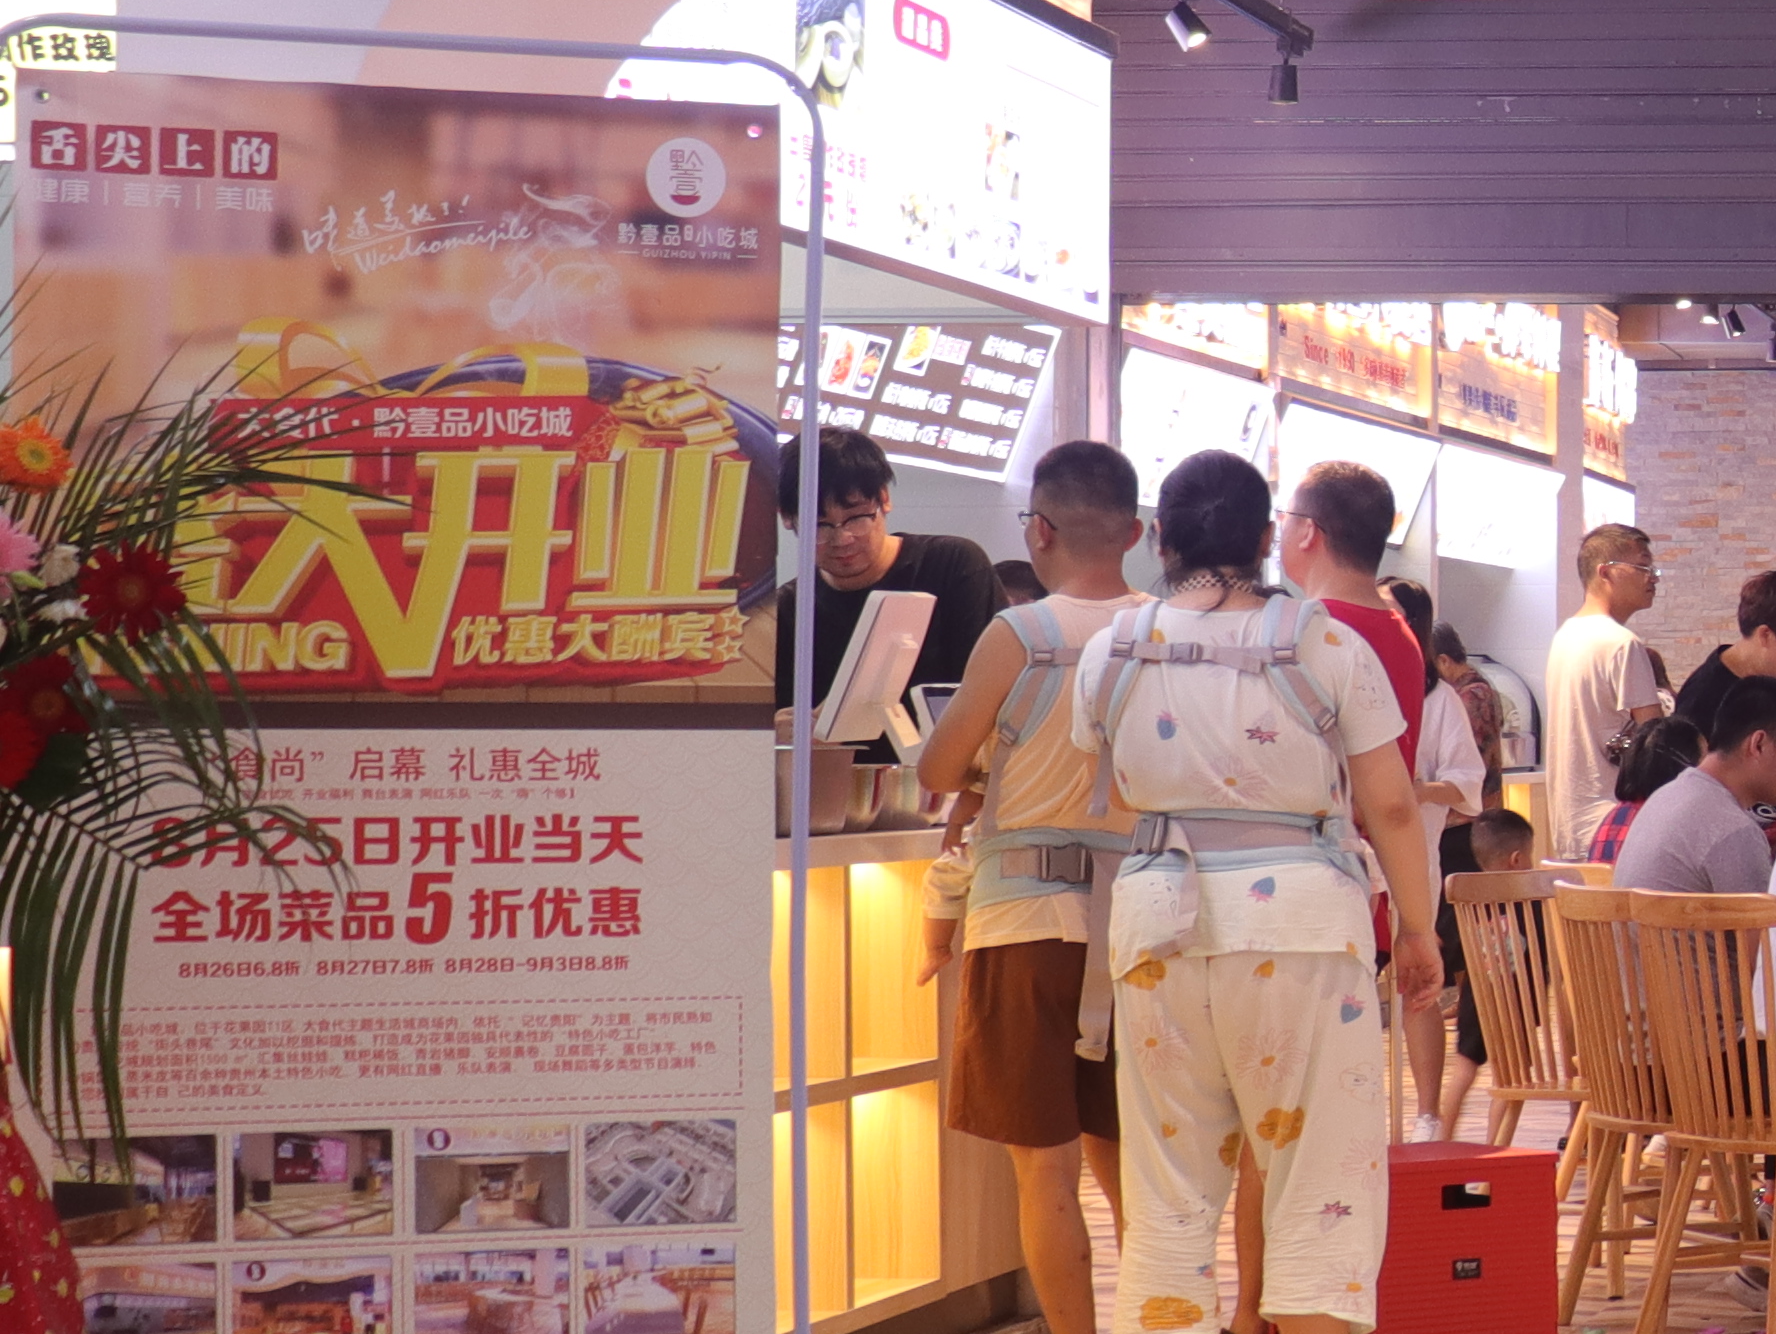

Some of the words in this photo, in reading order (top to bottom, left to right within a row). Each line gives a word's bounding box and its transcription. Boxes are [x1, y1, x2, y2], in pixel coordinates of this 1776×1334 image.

[37, 125, 273, 176] 舌尖上的
[450, 608, 722, 667] 优惠大酬宾
[348, 747, 427, 784] 启幕
[448, 747, 602, 784] 礼惠全城
[151, 815, 644, 869] 8月25日开业当天
